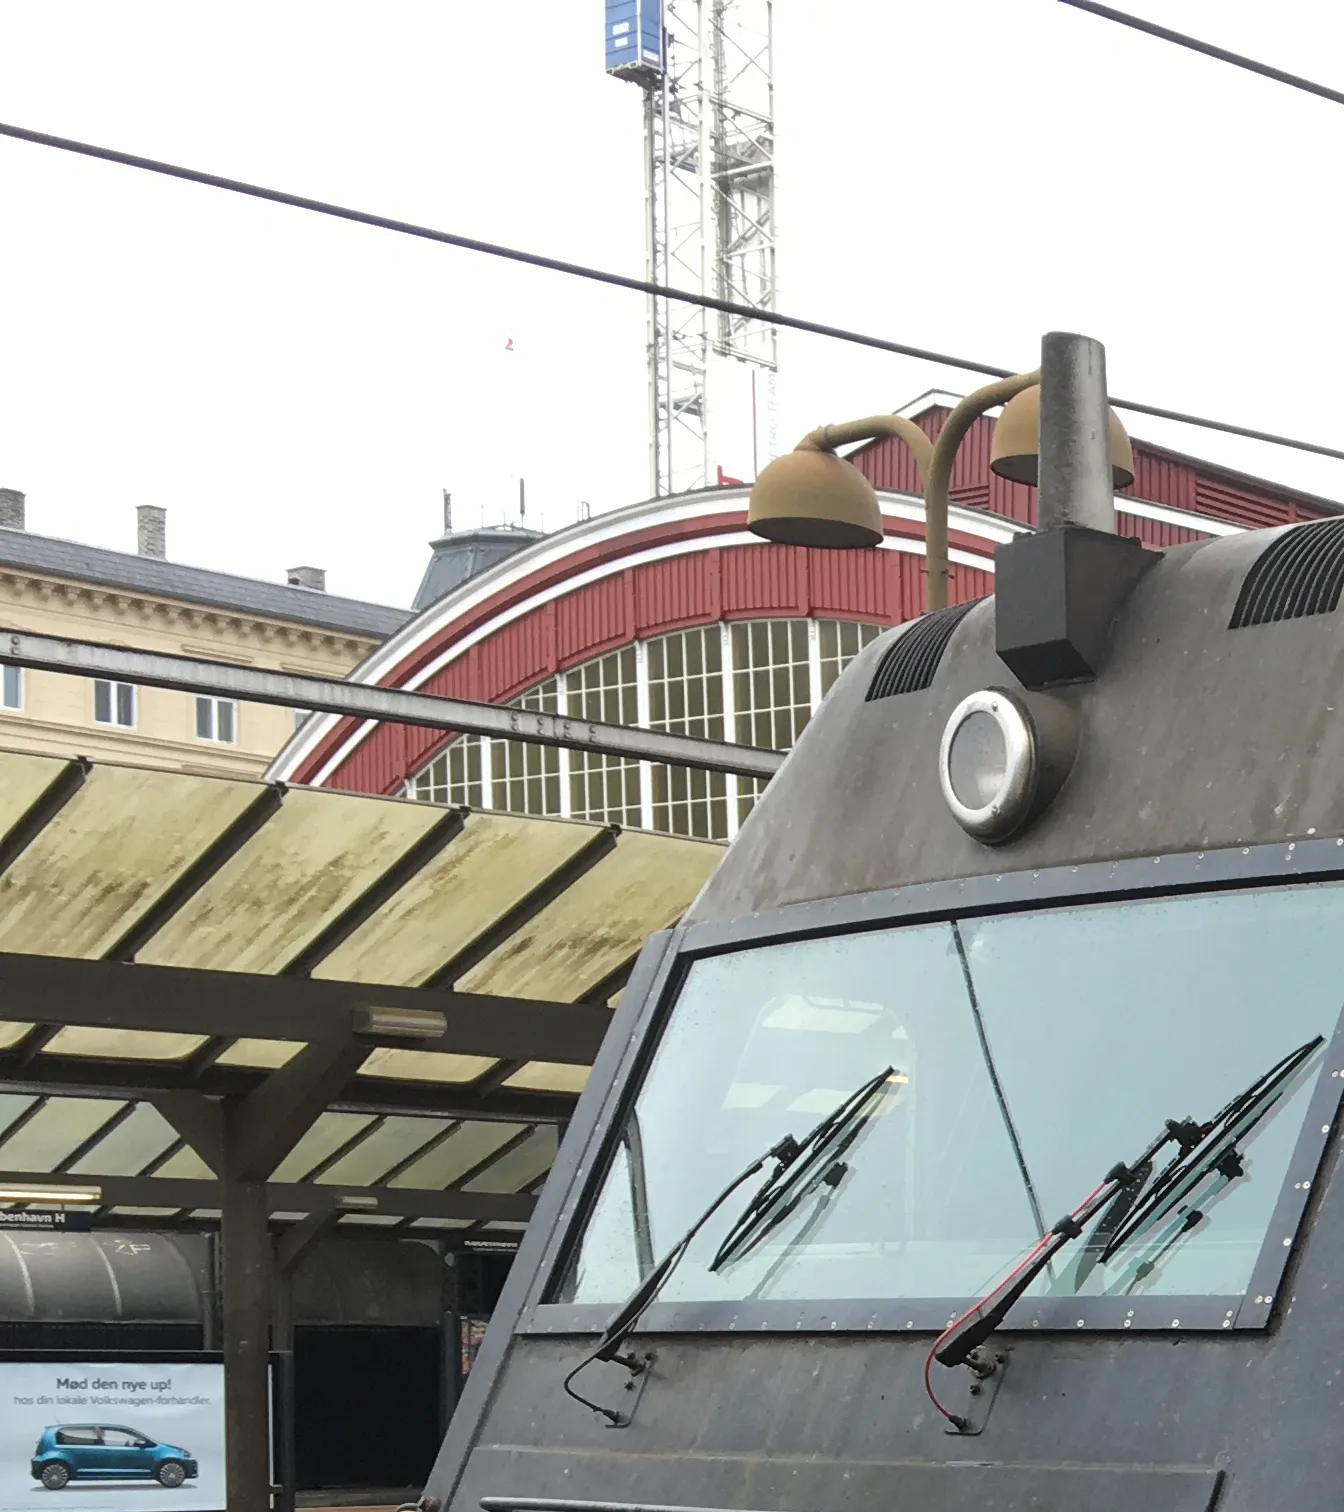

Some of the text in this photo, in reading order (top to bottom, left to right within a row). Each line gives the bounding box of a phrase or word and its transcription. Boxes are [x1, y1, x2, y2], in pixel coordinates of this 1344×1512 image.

[767, 418, 779, 460] ETRO
[55, 1213, 65, 1222] H
[56, 1378, 172, 1392] Mød den nye up!
